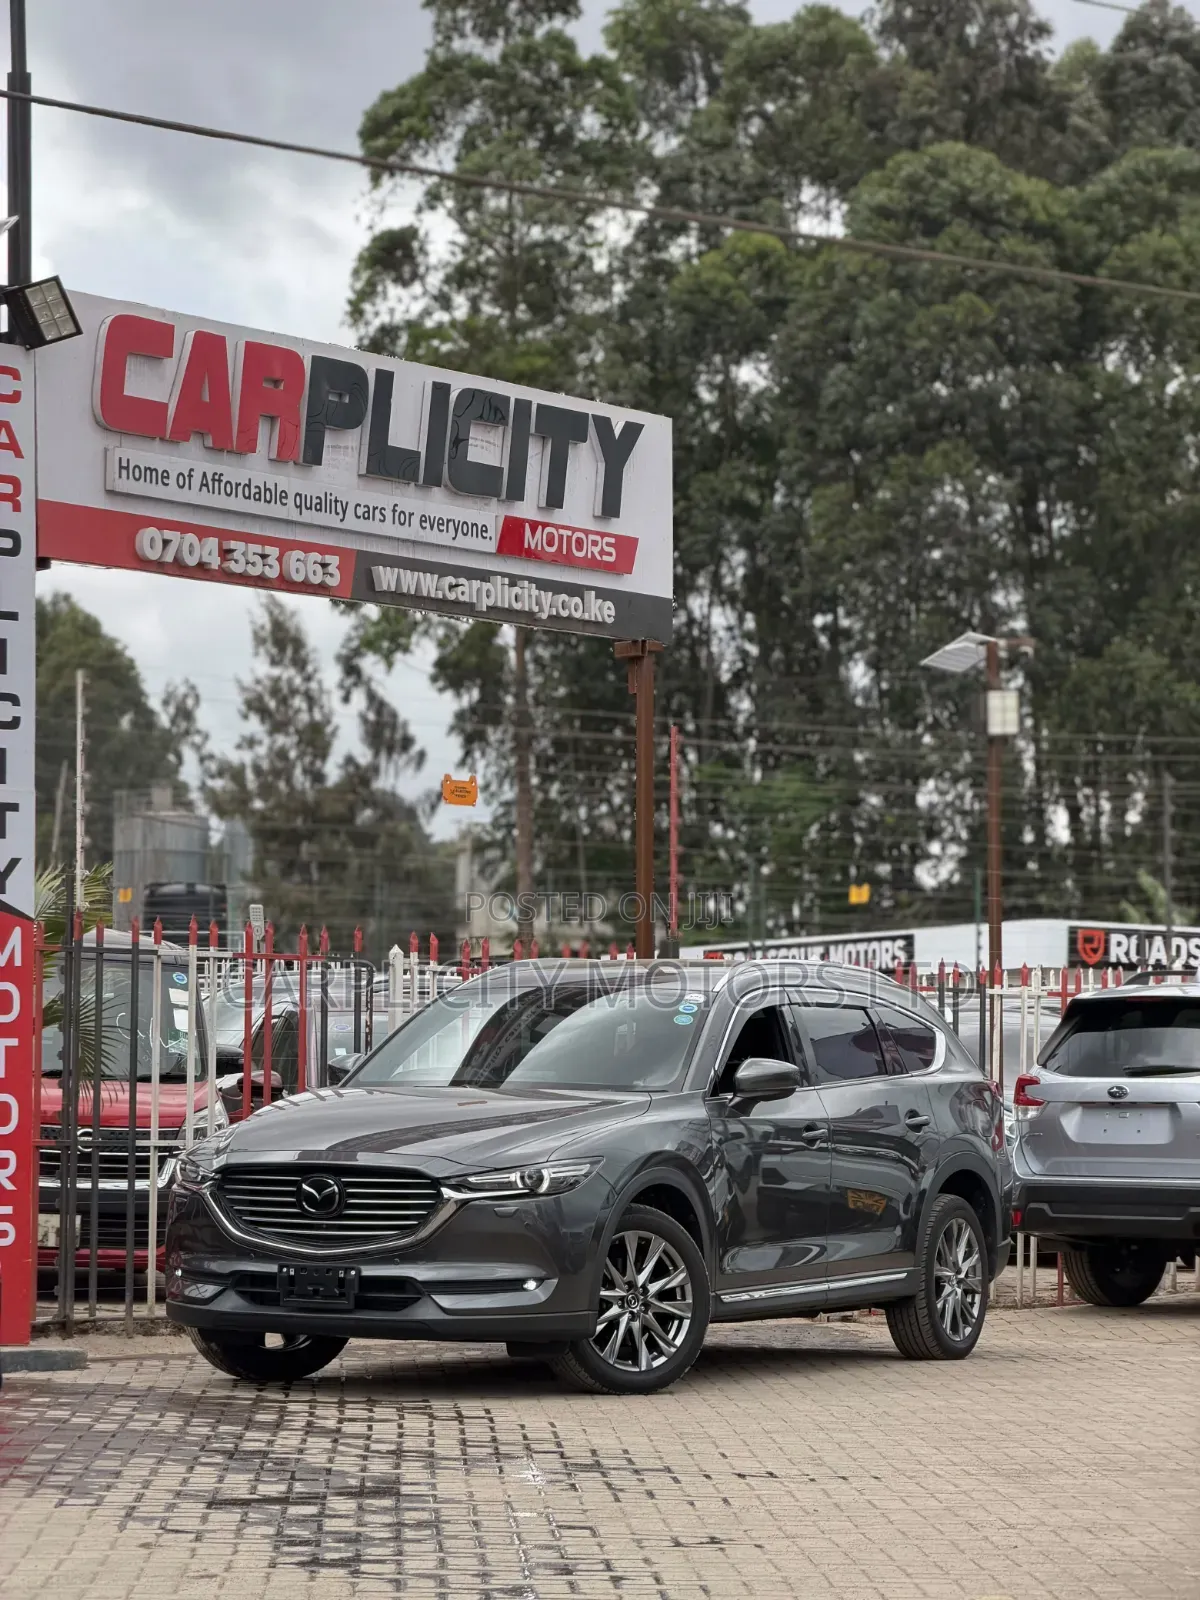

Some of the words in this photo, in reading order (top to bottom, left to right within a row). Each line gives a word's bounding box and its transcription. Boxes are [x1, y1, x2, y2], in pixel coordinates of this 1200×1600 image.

[96, 312, 645, 519] CARPLICITY
[117, 456, 170, 486] Home
[175, 463, 195, 489] of
[198, 470, 289, 507] Affordable
[293, 490, 349, 523] quality
[353, 502, 387, 524] cars
[390, 504, 415, 529] for
[418, 513, 493, 541] everyone.
[135, 526, 221, 571] 0704
[221, 539, 280, 579] 353
[283, 550, 341, 588] 663
[523, 522, 617, 563] MOTORS
[371, 565, 616, 624] www.carplicity.co.ke
[828, 939, 908, 970] MOTORS
